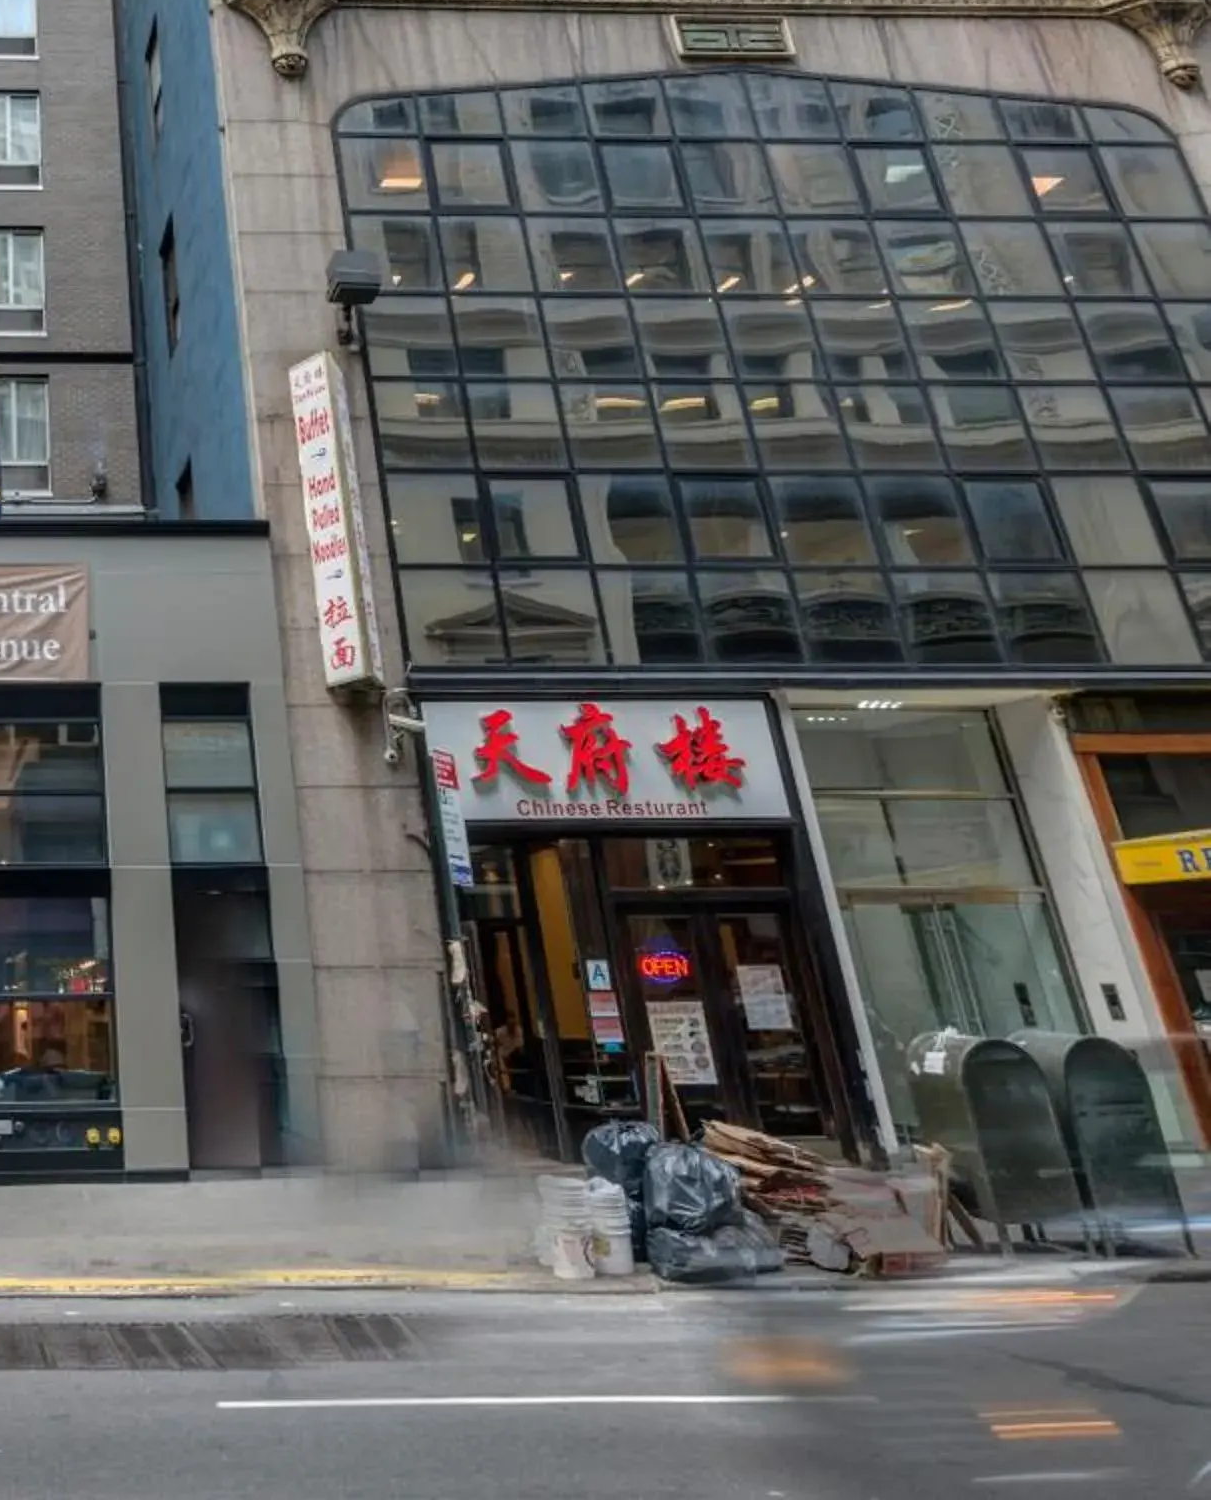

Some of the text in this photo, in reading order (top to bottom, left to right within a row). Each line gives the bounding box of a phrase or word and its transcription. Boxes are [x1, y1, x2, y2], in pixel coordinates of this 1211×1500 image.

[471, 702, 746, 795] 天府楼
[516, 799, 708, 817] Chinese Resturant
[592, 963, 606, 981] A
[641, 958, 689, 977] OPEN
